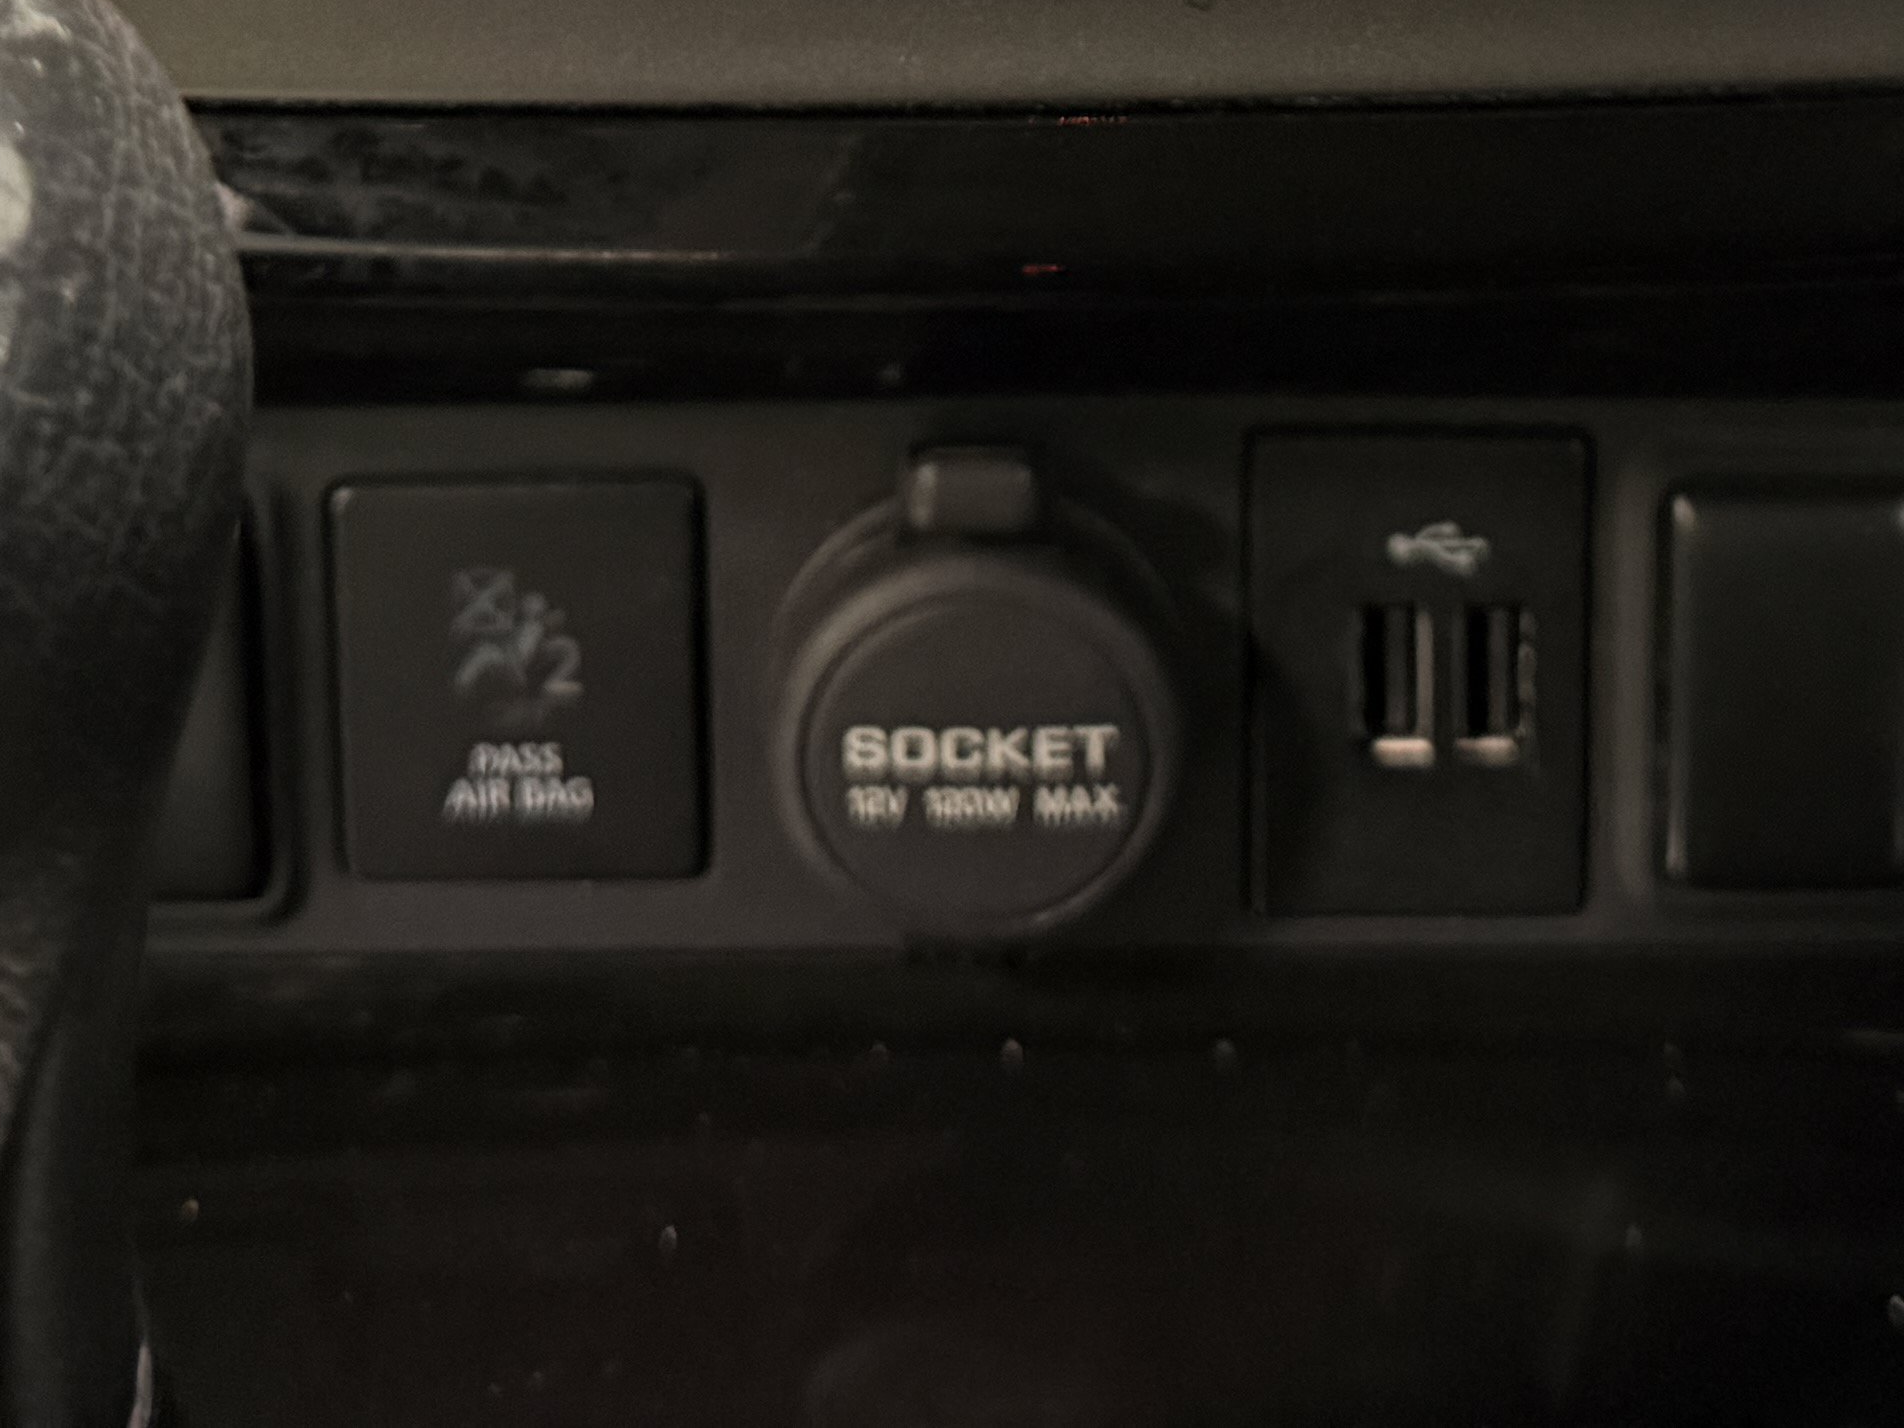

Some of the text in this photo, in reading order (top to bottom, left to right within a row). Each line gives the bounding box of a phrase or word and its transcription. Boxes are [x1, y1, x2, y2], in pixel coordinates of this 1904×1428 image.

[467, 741, 565, 778] PASS
[842, 724, 1119, 782] SOCKET
[443, 776, 595, 821] AIR BAG
